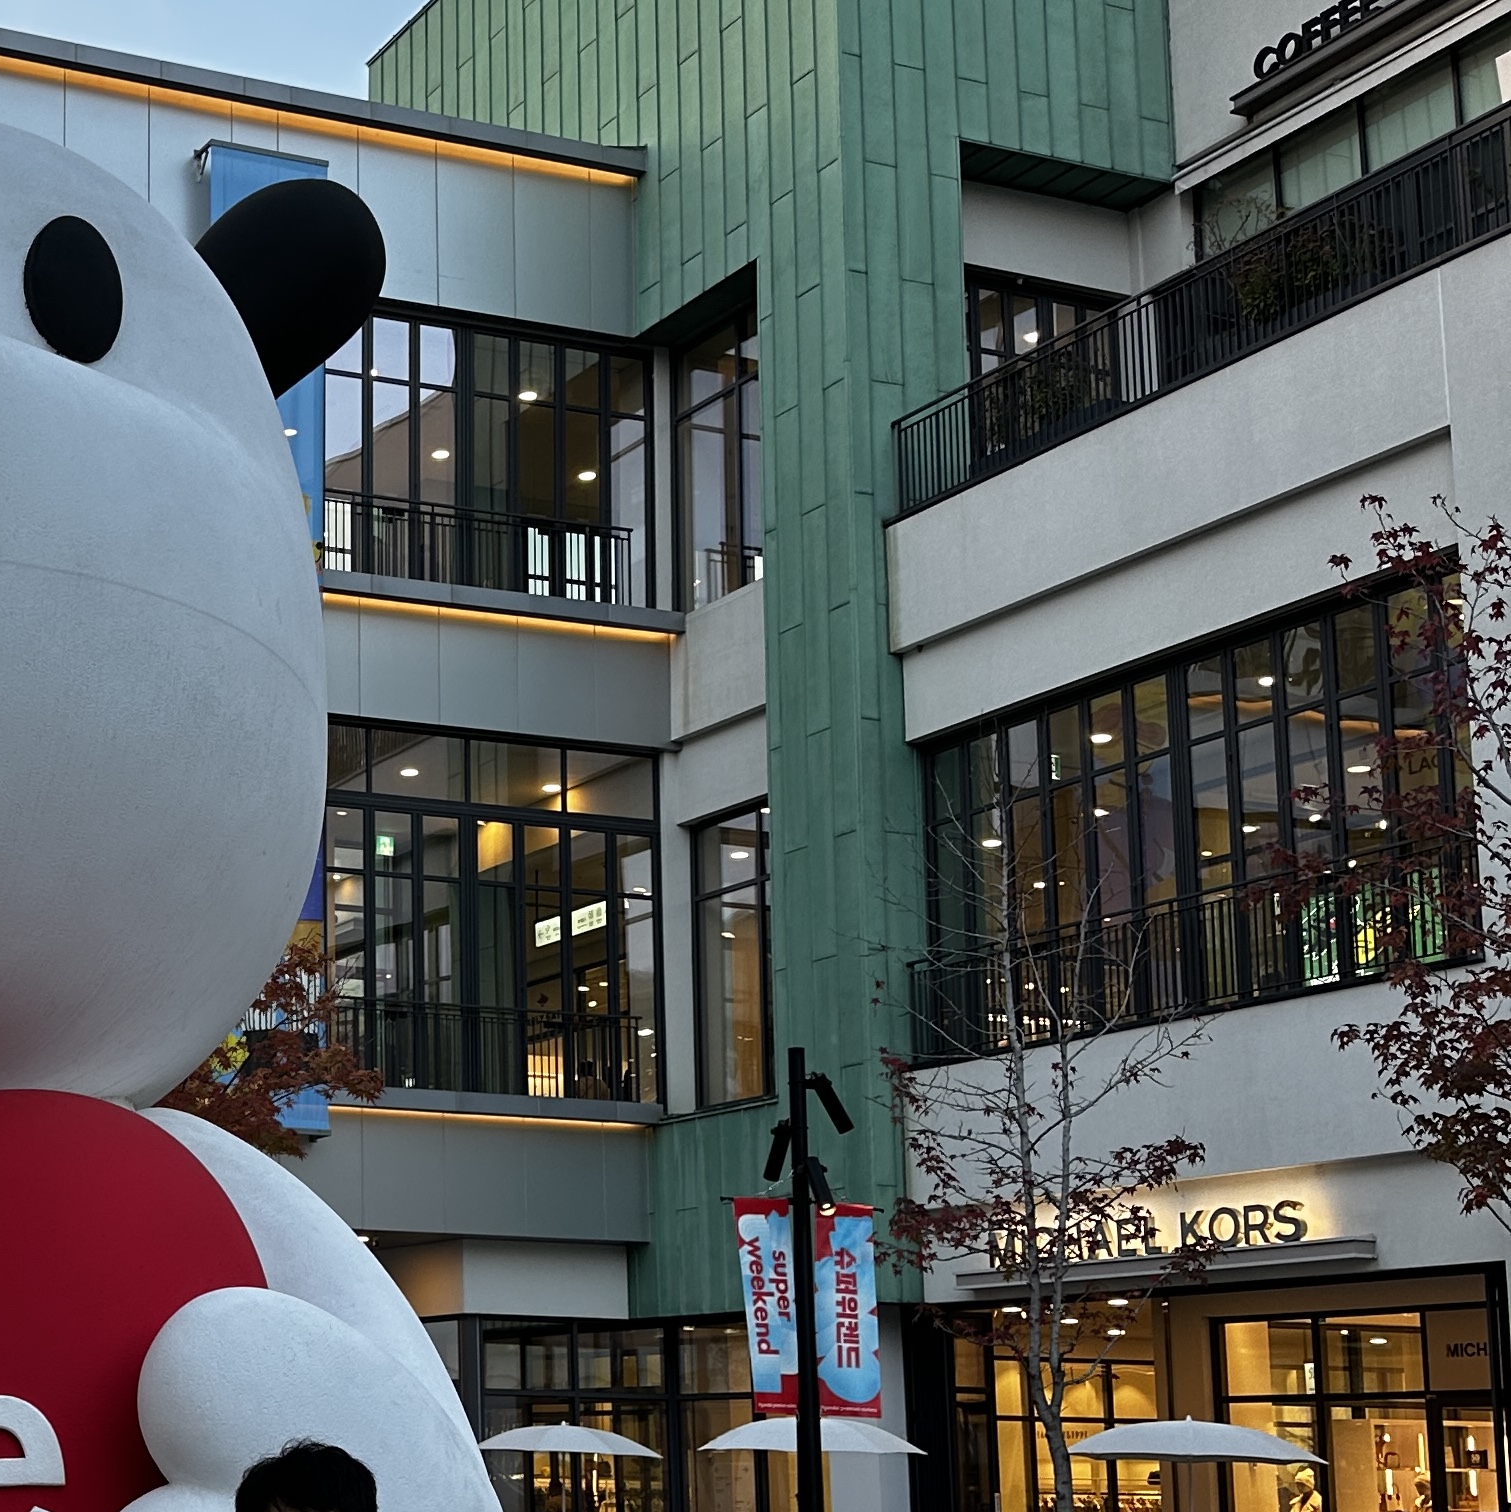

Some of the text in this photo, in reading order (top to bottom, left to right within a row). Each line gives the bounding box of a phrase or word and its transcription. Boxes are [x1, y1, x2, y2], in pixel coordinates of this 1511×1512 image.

[1179, 1200, 1307, 1249] KORS
[745, 1236, 780, 1355] weekend
[772, 1250, 790, 1323] super
[834, 1247, 861, 1369] 슈퍼위켄드
[1446, 1342, 1487, 1357] MICH
